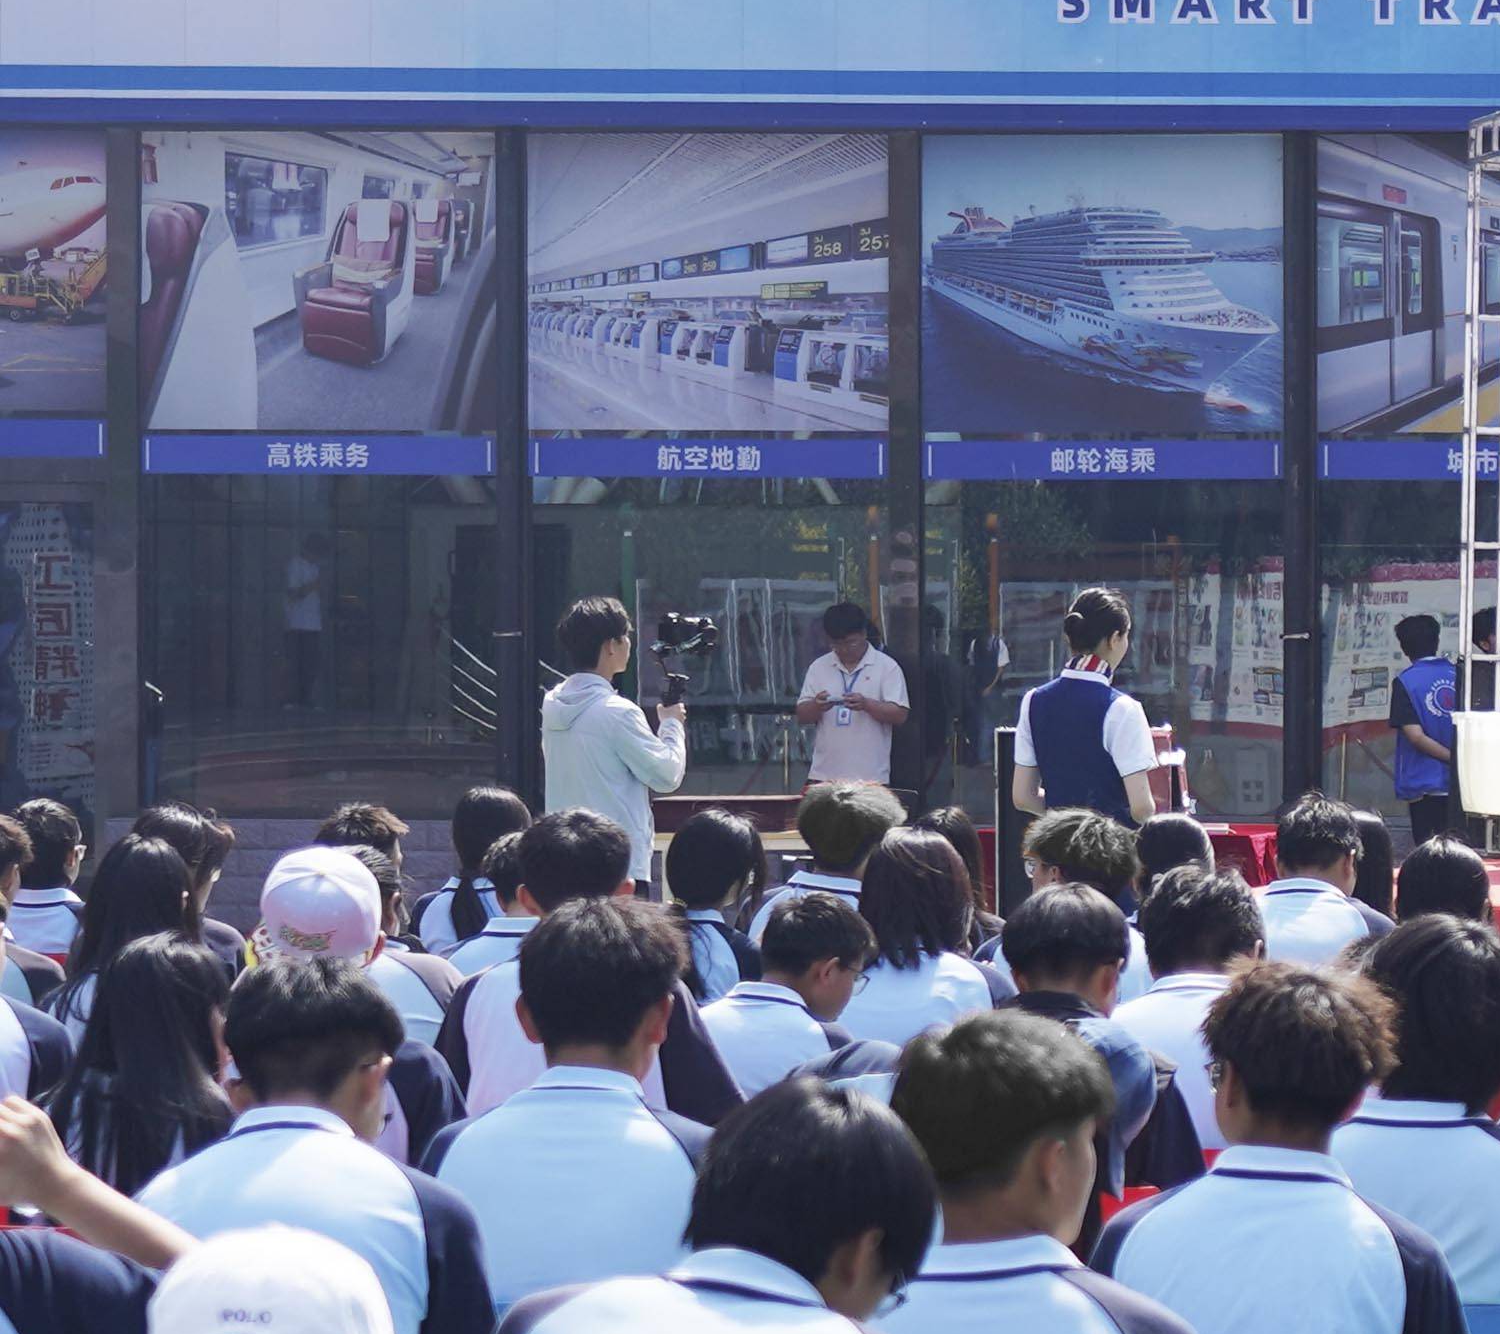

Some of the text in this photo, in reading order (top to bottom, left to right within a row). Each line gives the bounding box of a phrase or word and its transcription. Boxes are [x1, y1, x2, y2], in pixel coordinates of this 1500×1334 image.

[813, 241, 842, 258] 258
[267, 442, 370, 468] 高铁乘务
[657, 445, 761, 472] 航空地勤
[1050, 447, 1156, 474] 邮轮海乘
